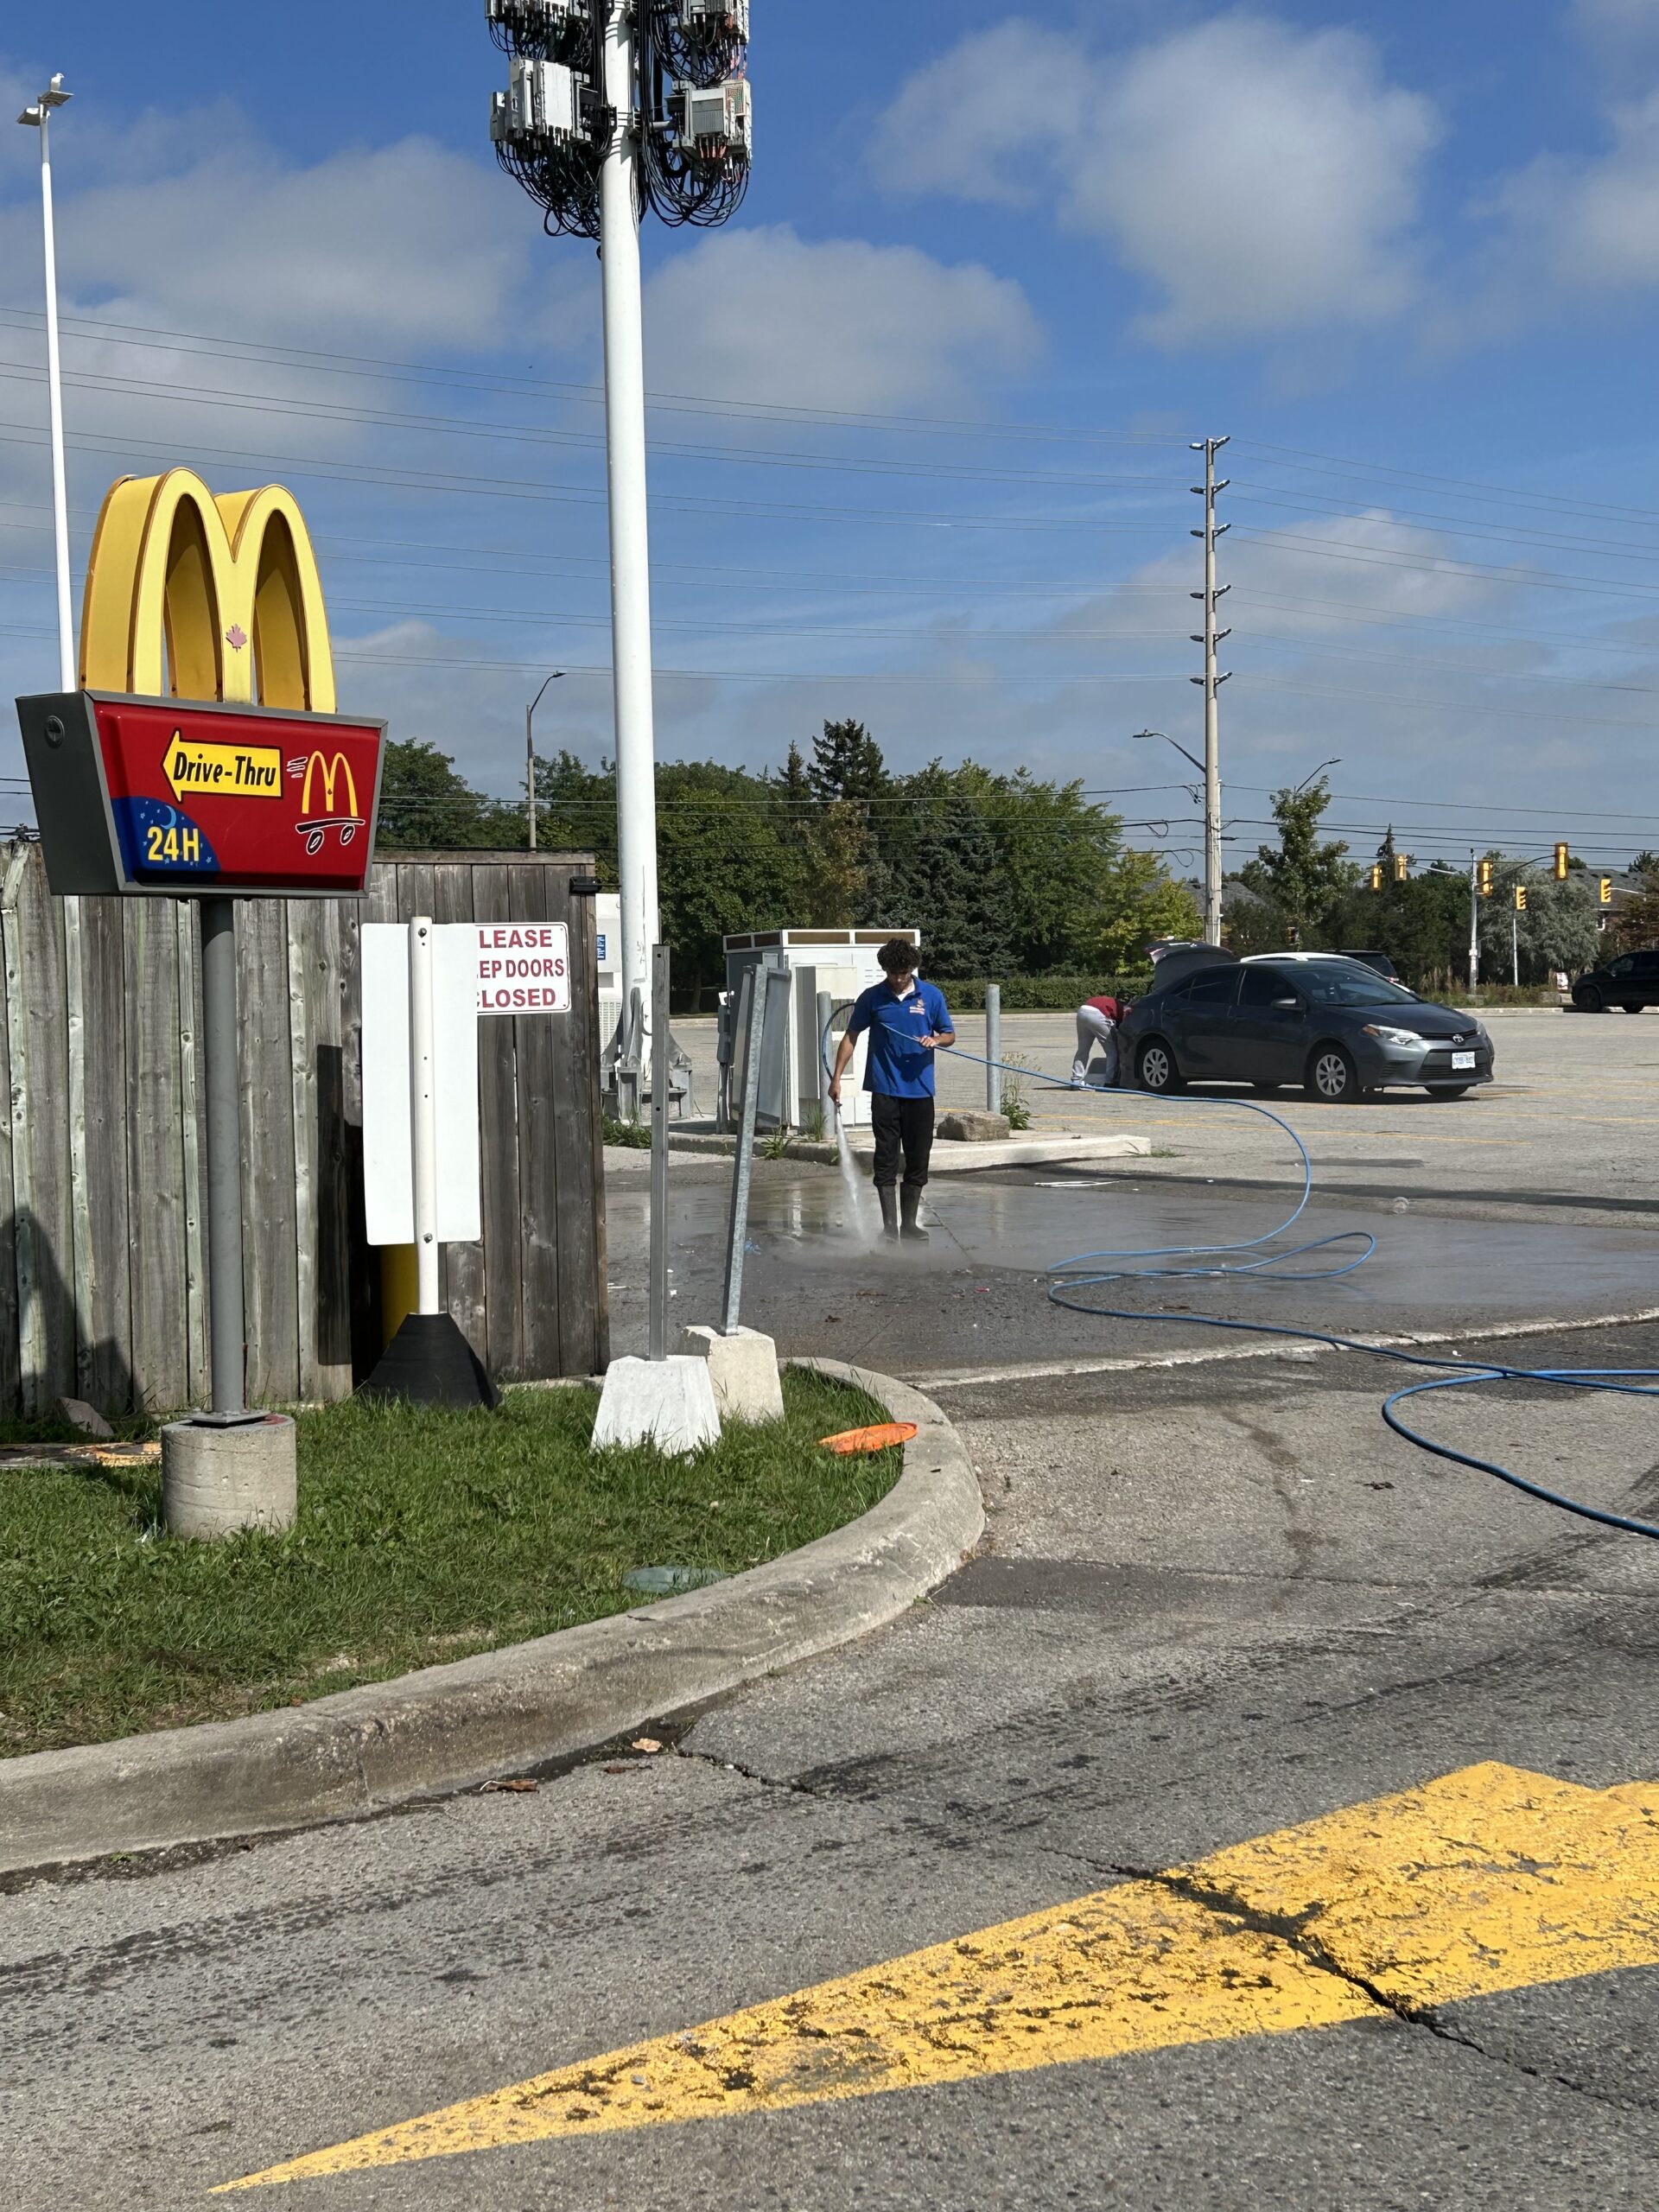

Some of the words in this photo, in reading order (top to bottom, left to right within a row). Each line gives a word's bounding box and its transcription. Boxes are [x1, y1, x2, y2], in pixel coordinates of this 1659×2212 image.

[173, 752, 276, 787] Drive-Thru
[147, 826, 200, 862] 24H
[479, 929, 553, 949] LEASE
[477, 960, 502, 979] EP
[505, 958, 564, 978] DOORS
[477, 988, 556, 1008] LOSED
